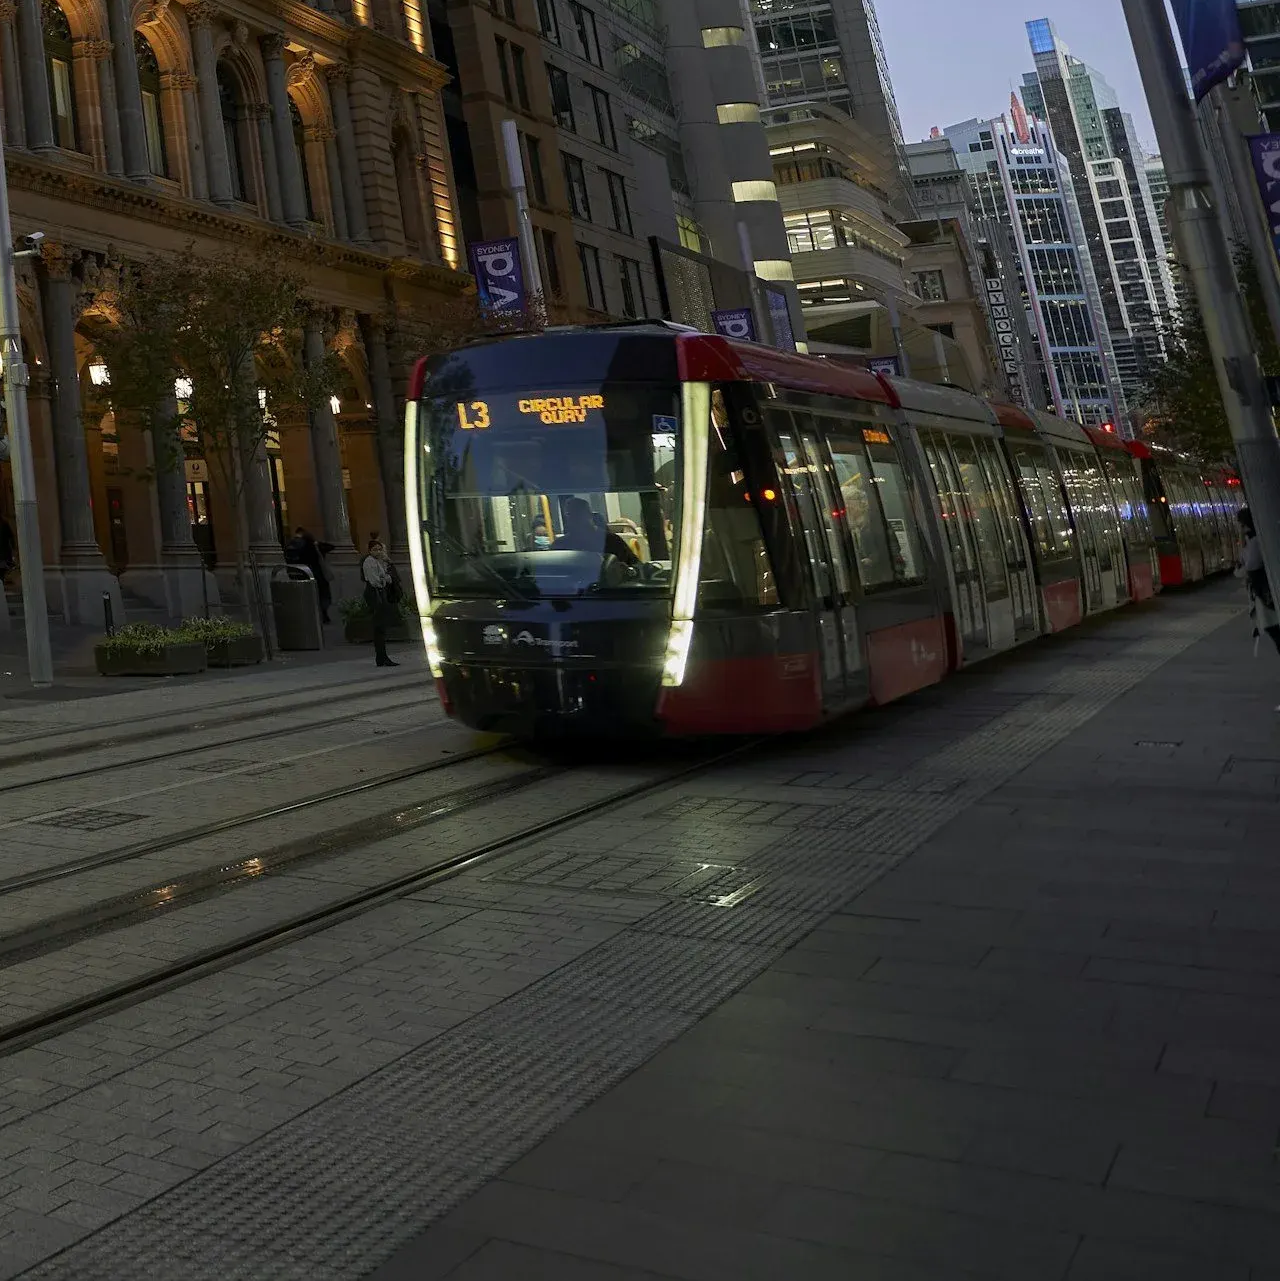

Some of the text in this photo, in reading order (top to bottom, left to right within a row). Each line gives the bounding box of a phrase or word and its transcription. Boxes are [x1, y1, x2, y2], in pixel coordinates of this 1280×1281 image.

[1018, 147, 1045, 156] breathe
[476, 242, 512, 256] SYDNEY
[988, 279, 1017, 373] DYMOCKS
[517, 393, 605, 413] CIRCULAR
[456, 400, 491, 429] L3
[539, 407, 588, 425] QUAY
